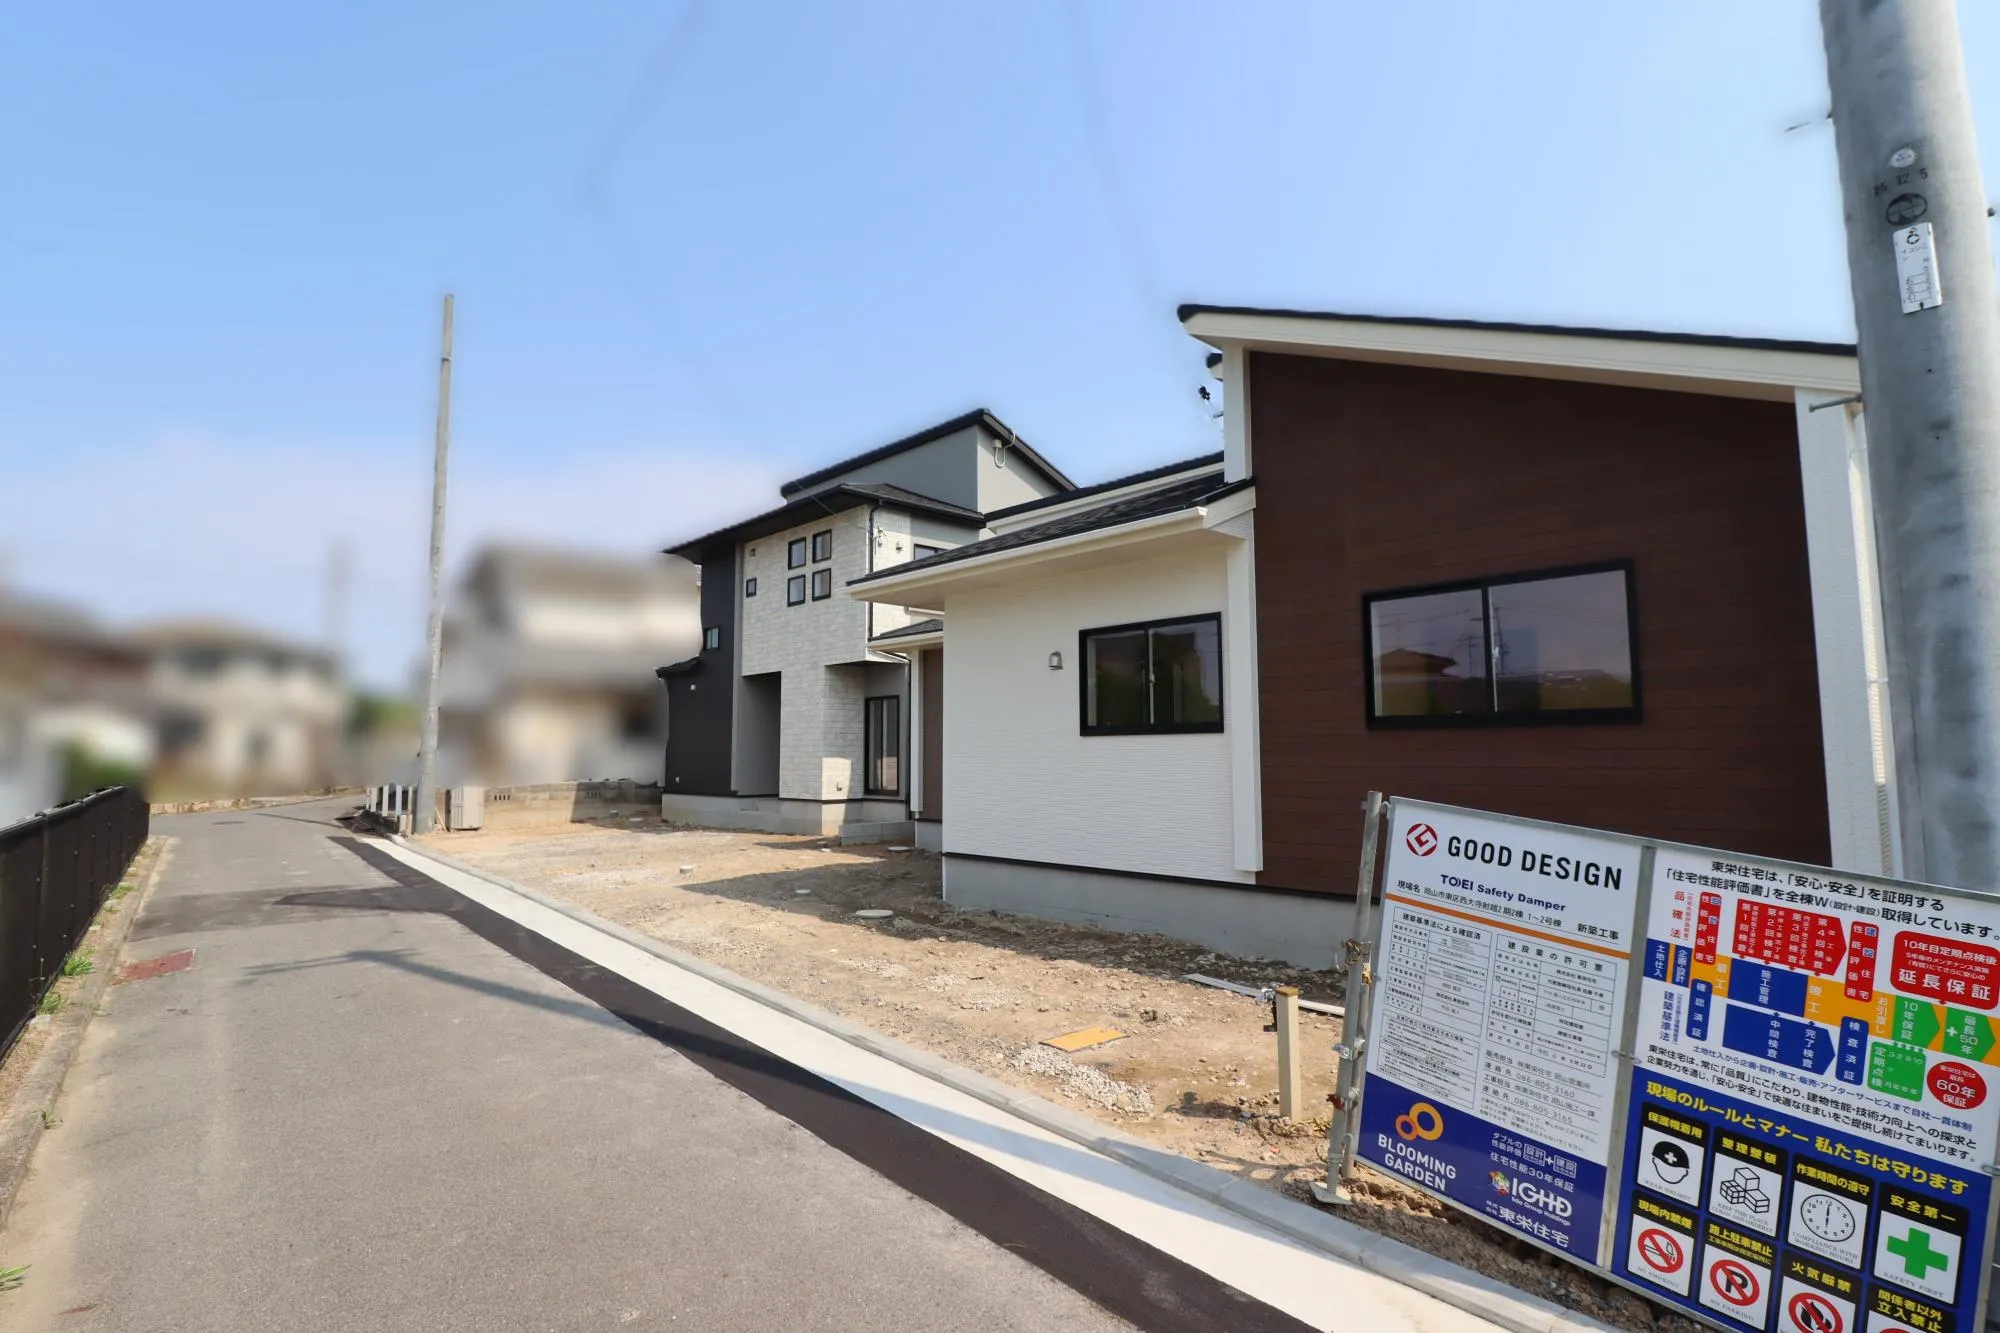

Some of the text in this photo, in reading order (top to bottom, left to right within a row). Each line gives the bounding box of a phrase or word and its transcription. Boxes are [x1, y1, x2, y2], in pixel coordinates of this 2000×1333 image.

[1447, 835, 1622, 891] GOOD DESIGN
[1397, 880, 1420, 894] 現場名
[1577, 923, 1619, 941] 新築工事
[1477, 884, 1514, 902] Safety
[1517, 892, 1566, 912] Damper
[1654, 944, 1665, 978] 土地仕入
[1903, 938, 1998, 966] 10年目定期点検後
[1758, 969, 1772, 1004] 施工管理
[1898, 968, 1992, 1001] 延長保証
[1659, 990, 1675, 1042] 建築基準法
[1900, 1000, 1919, 1040] 10年保証
[1767, 1020, 1781, 1059] 中間検査
[1802, 1028, 1816, 1069] 完了検査
[1843, 1021, 1861, 1081] 検査済証
[1870, 1046, 1886, 1087] 定期点検
[1936, 1079, 1977, 1100] 60年
[1942, 1094, 1968, 1108] 保証
[1493, 1132, 1523, 1149] ダブルの
[1526, 1146, 1544, 1160] 設計
[1646, 1080, 1809, 1142] 現場のルールとマナー
[1815, 1135, 1969, 1196] 私たちは守ります
[1722, 1136, 1778, 1166] 整理整頓
[1378, 1133, 1457, 1180] BLOOMING
[1384, 1152, 1446, 1192] GARDEN
[1490, 1151, 1575, 1192] 住宅性能30年保証
[1796, 1163, 1870, 1197] 作業時間の遵守
[1511, 1177, 1573, 1218] IGHD
[1890, 1194, 1956, 1222] 安全第一
[1499, 1205, 1569, 1248] 東栄住宅
[1709, 1223, 1773, 1258] 路上駐車禁止
[1838, 1246, 1858, 1262] WITH
[1792, 1261, 1852, 1294] 火気厳禁
[1883, 1270, 1945, 1298] SAFETY FIRST
[1877, 1302, 1942, 1333] 立入禁止
[1878, 1289, 1943, 1322] 関係者以外
